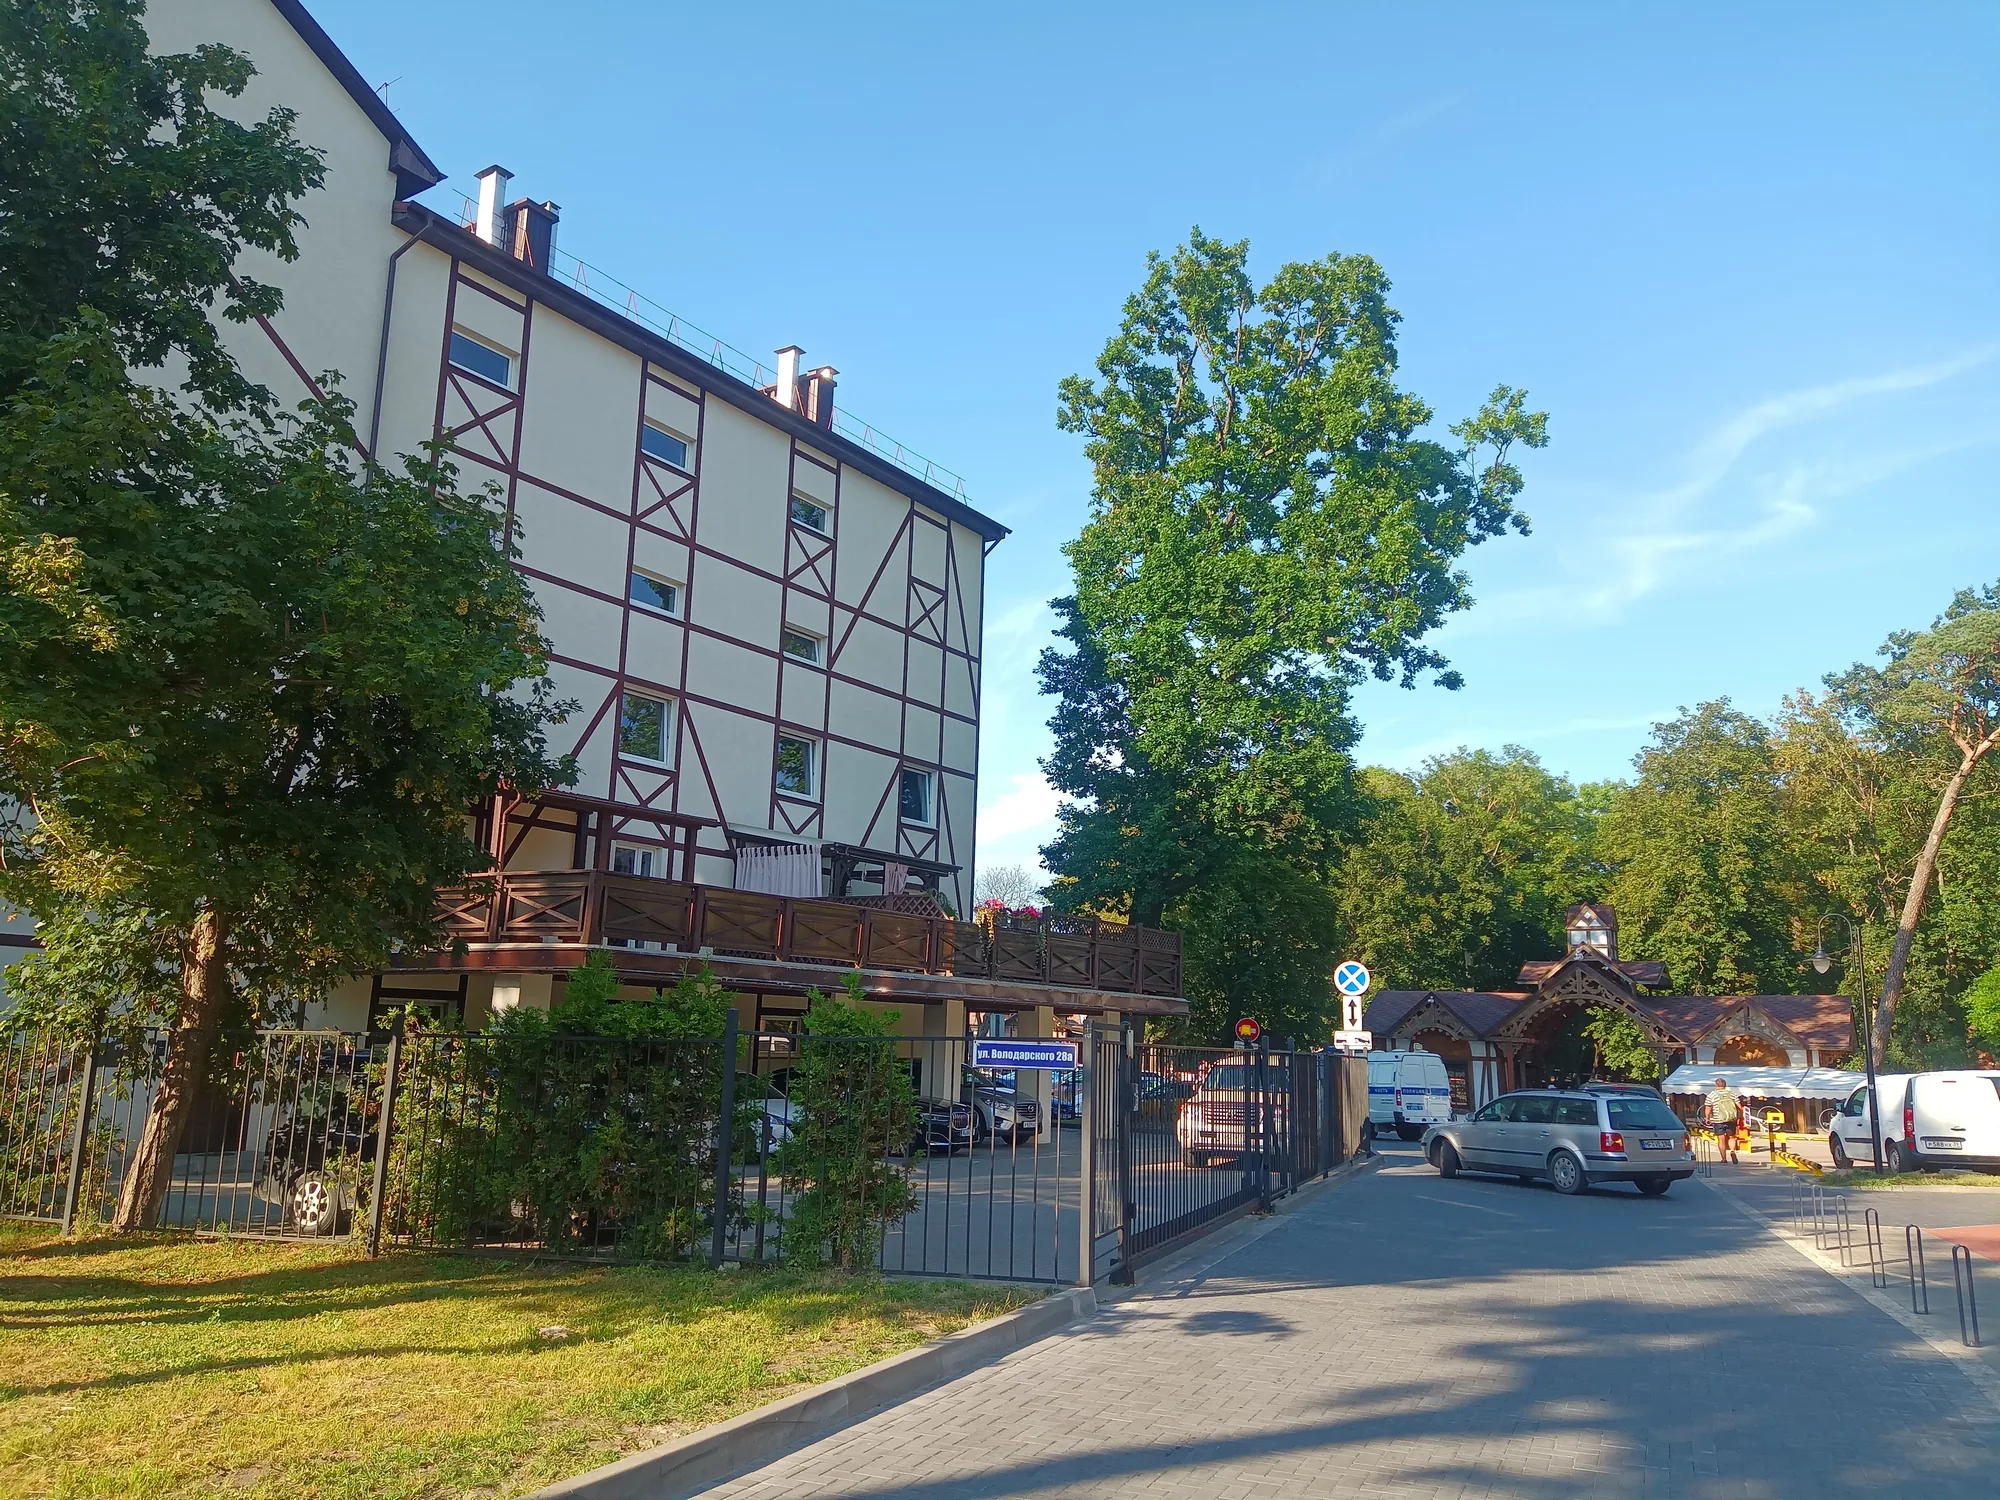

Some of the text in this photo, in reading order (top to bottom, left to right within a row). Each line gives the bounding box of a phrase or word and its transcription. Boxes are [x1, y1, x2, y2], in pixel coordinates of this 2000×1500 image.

[977, 1048, 1073, 1062] ул. Володарского 28а
